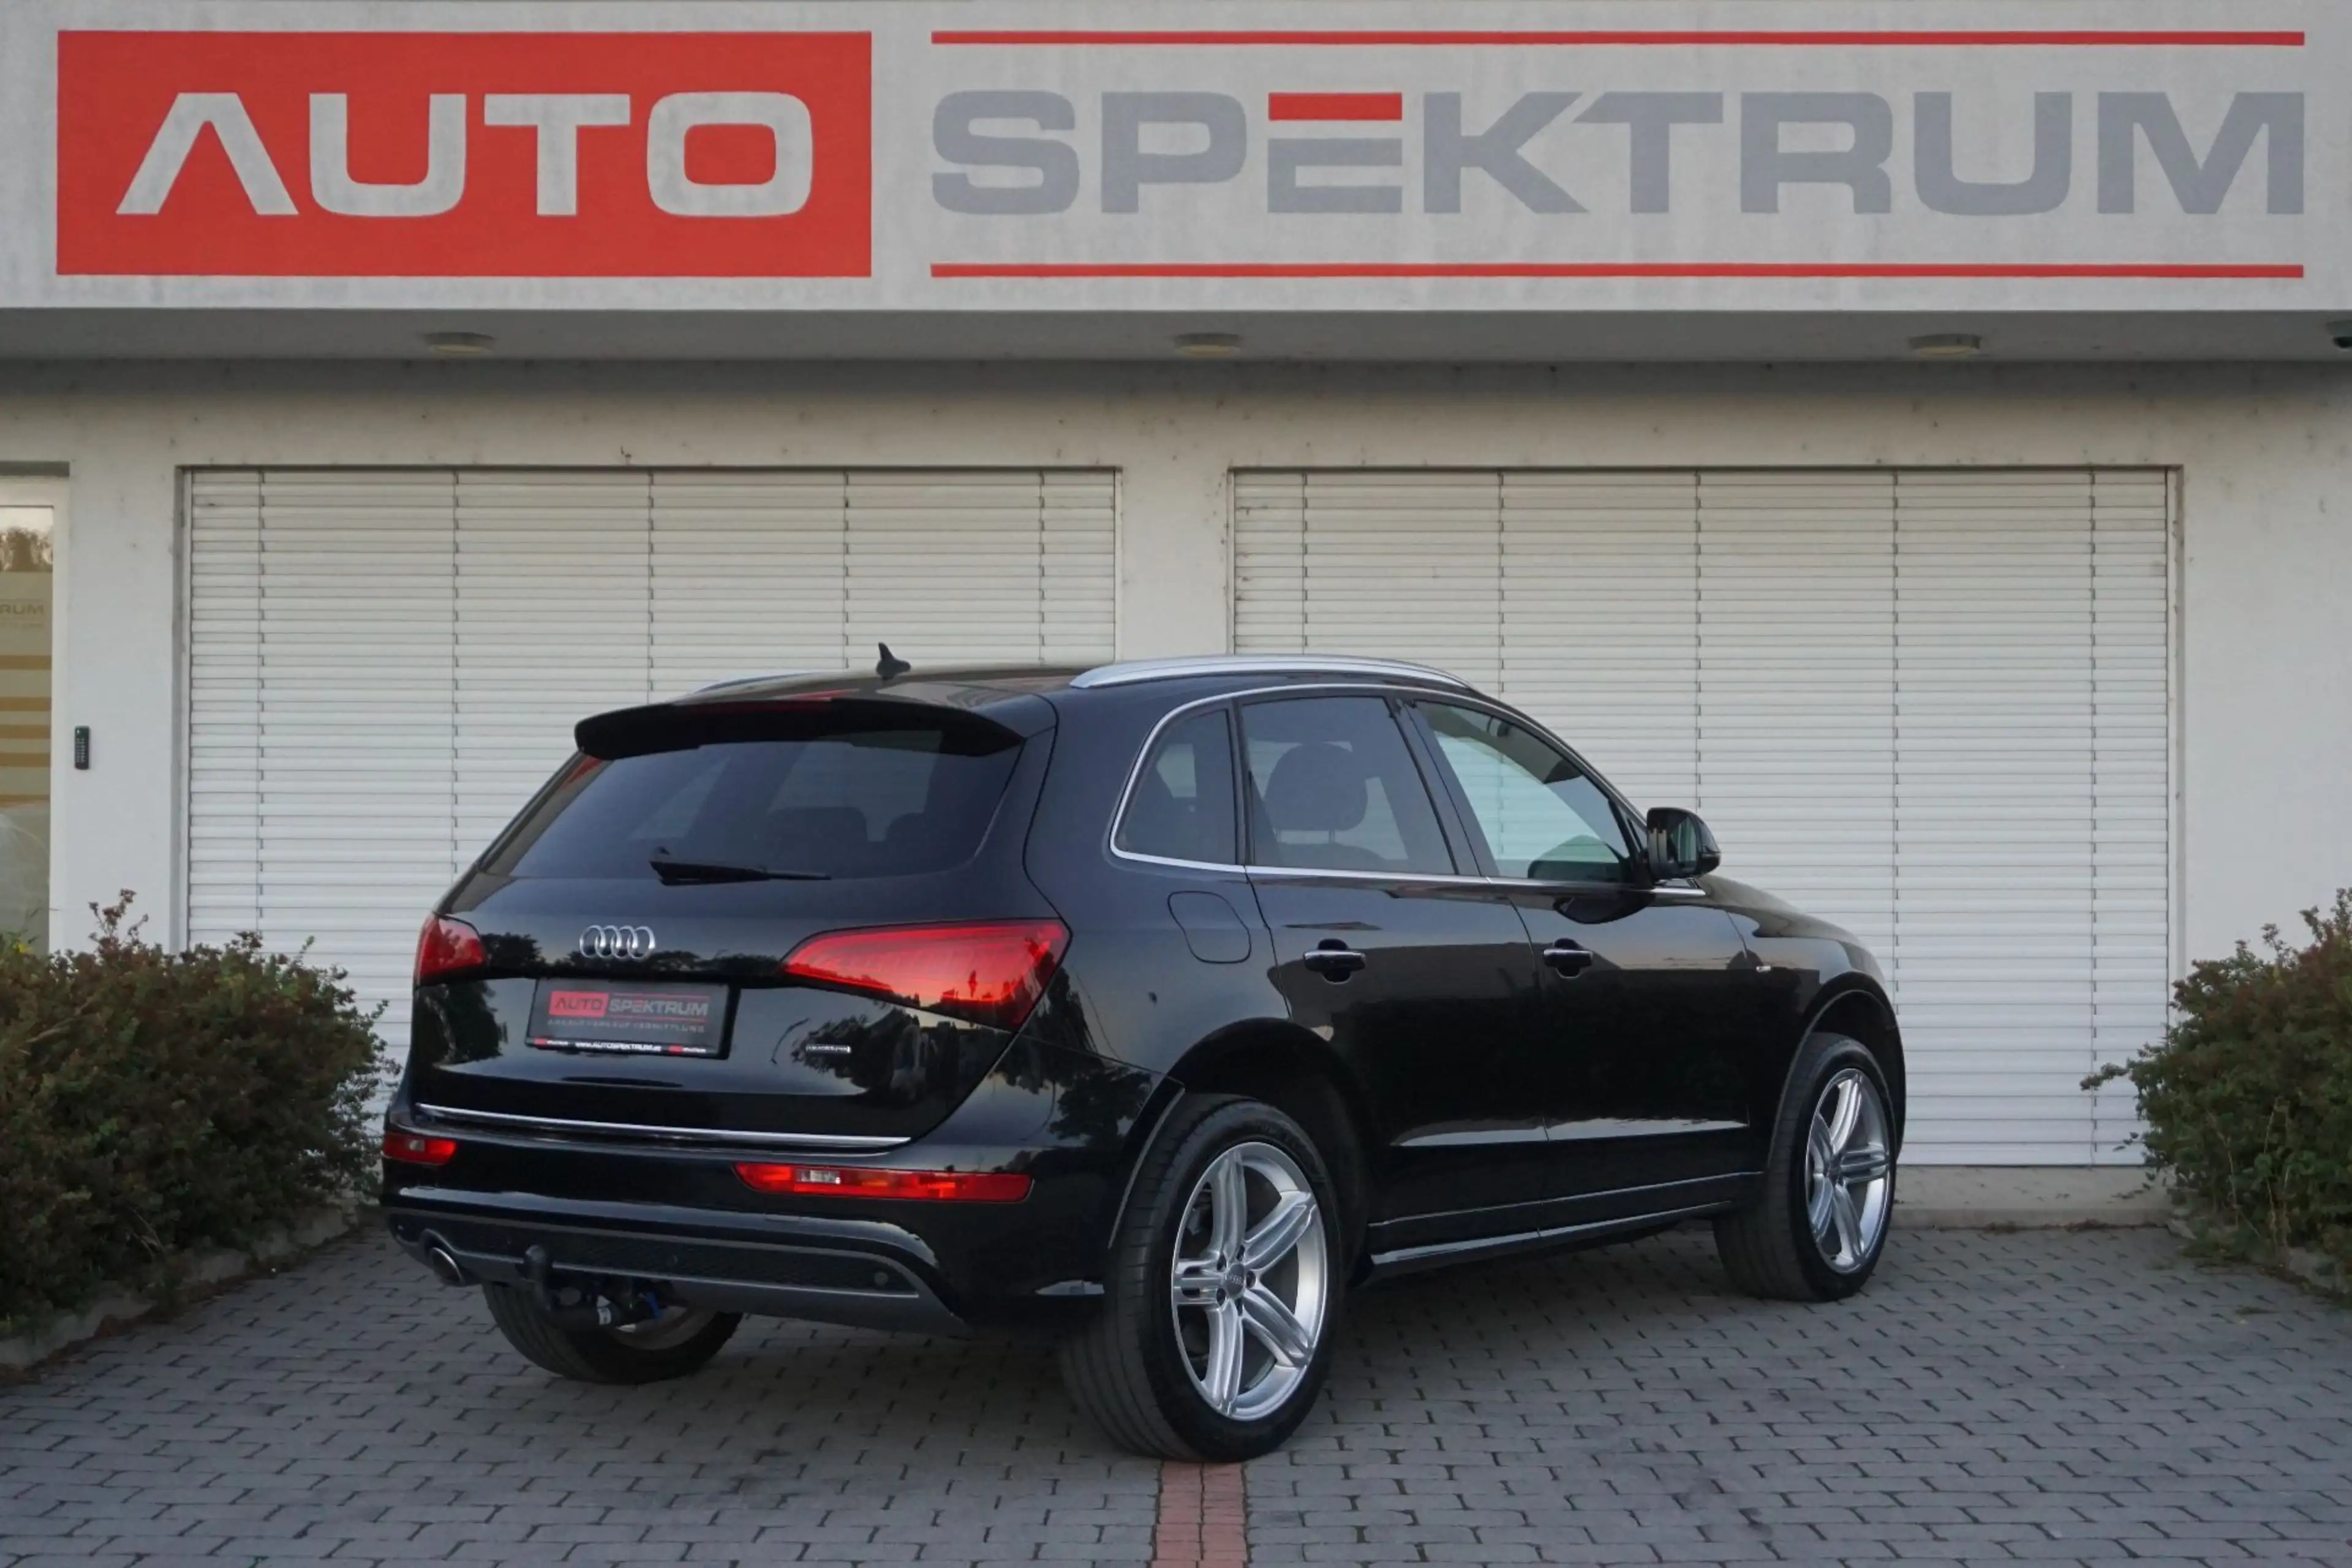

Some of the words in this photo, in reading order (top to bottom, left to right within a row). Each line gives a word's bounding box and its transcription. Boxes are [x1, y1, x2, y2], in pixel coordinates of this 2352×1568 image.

[116, 91, 813, 219] AUTO
[933, 91, 2304, 216] SPEKTRUM
[554, 997, 603, 1010] AUTO
[608, 998, 709, 1017] SPEKTRUM
